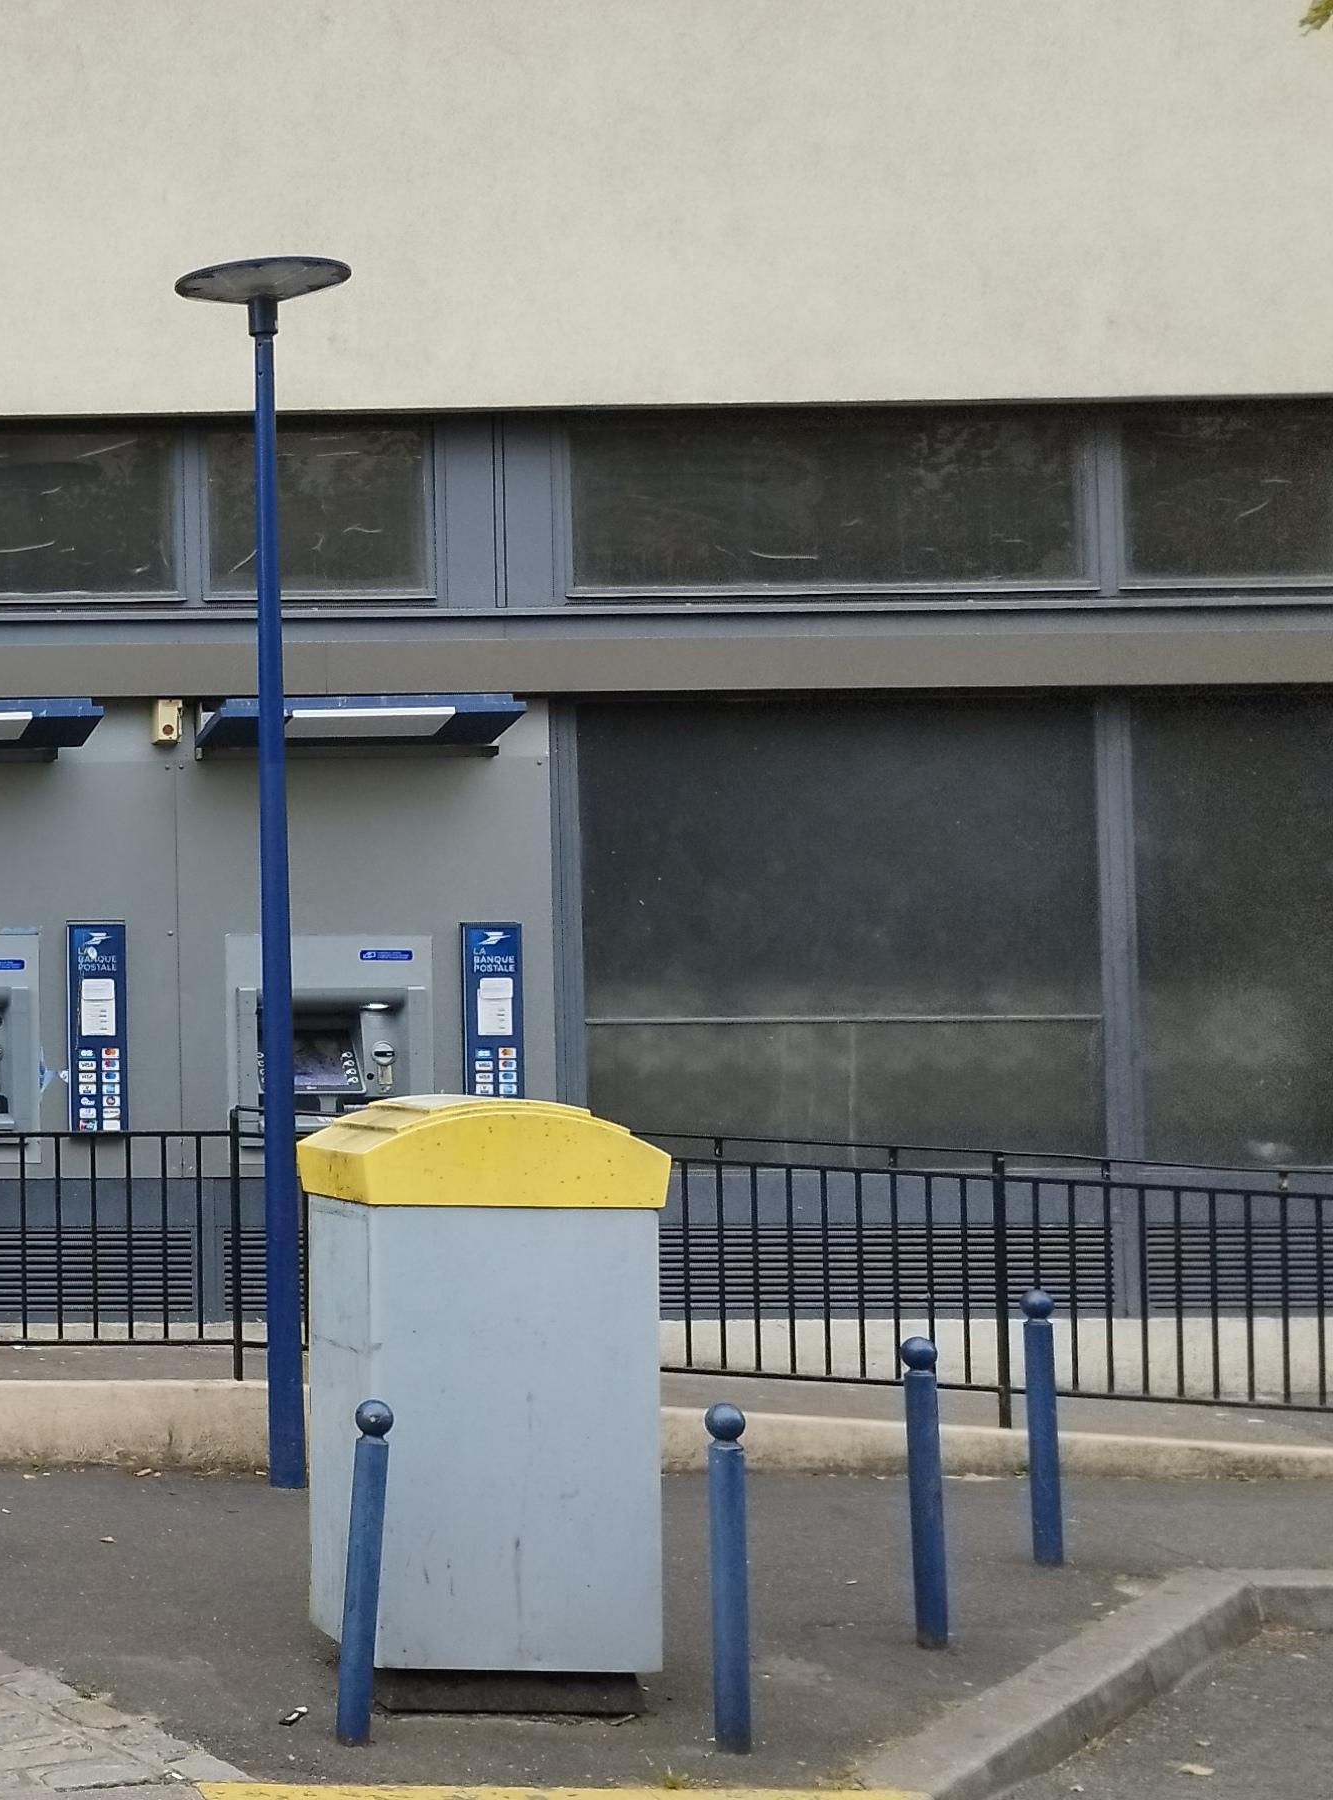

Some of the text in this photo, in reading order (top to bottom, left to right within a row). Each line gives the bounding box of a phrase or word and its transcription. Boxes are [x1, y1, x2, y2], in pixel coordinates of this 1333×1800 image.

[473, 946, 486, 955] LA
[473, 955, 515, 965] BANQUE
[78, 963, 117, 972] POSTALE
[473, 964, 515, 973] POSTALE
